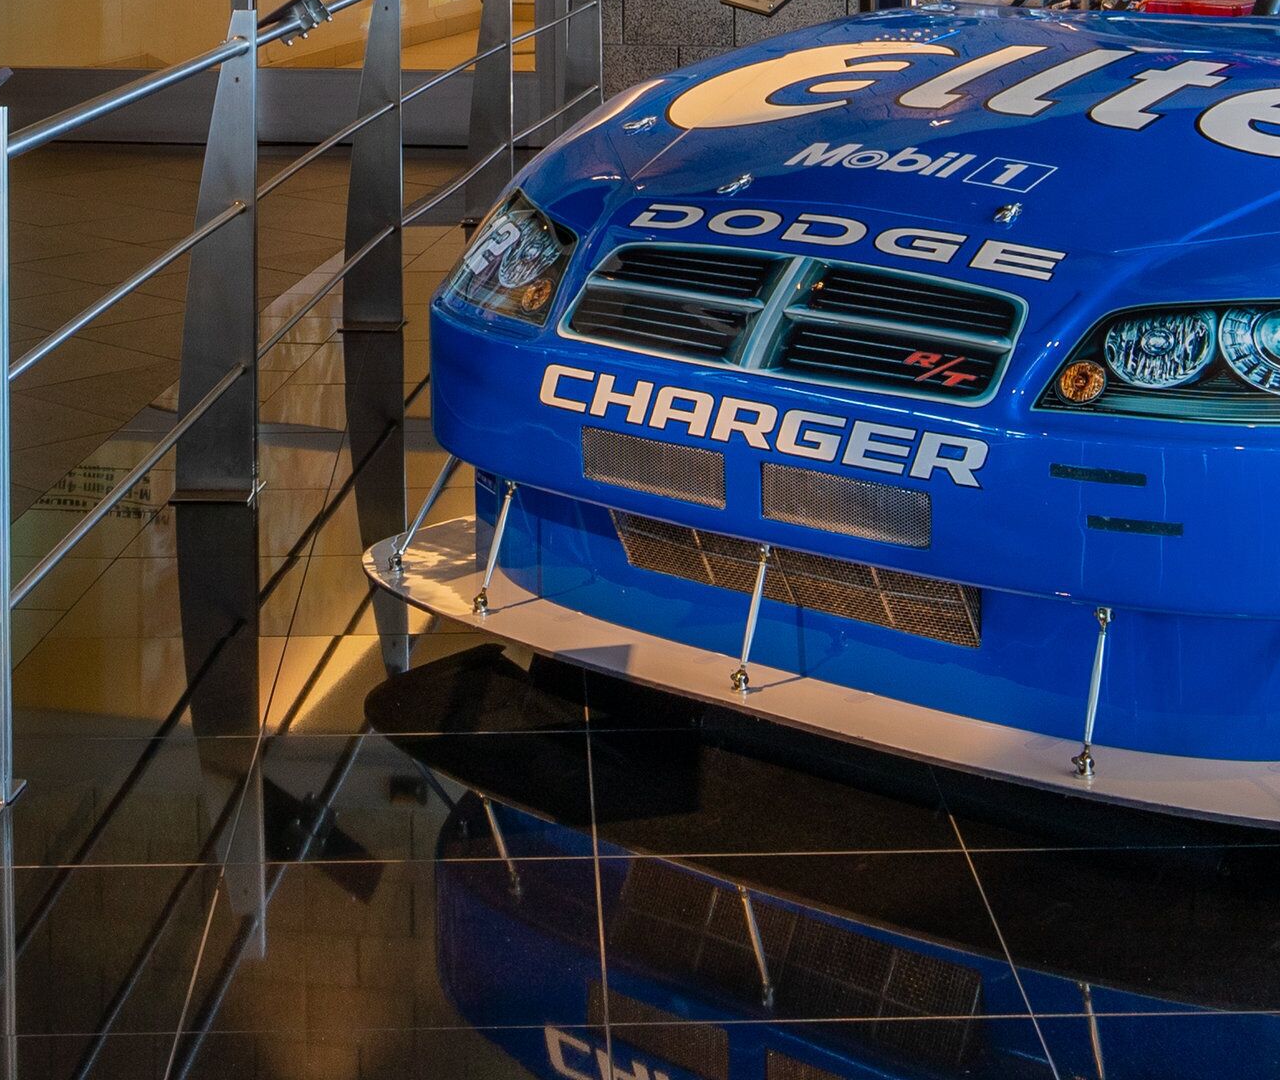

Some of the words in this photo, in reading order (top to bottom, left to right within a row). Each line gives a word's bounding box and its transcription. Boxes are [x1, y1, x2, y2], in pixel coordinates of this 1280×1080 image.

[784, 142, 977, 180] Mobil
[629, 204, 1066, 281] DODGE
[903, 351, 978, 387] R/T
[539, 363, 989, 489] CHARGER
